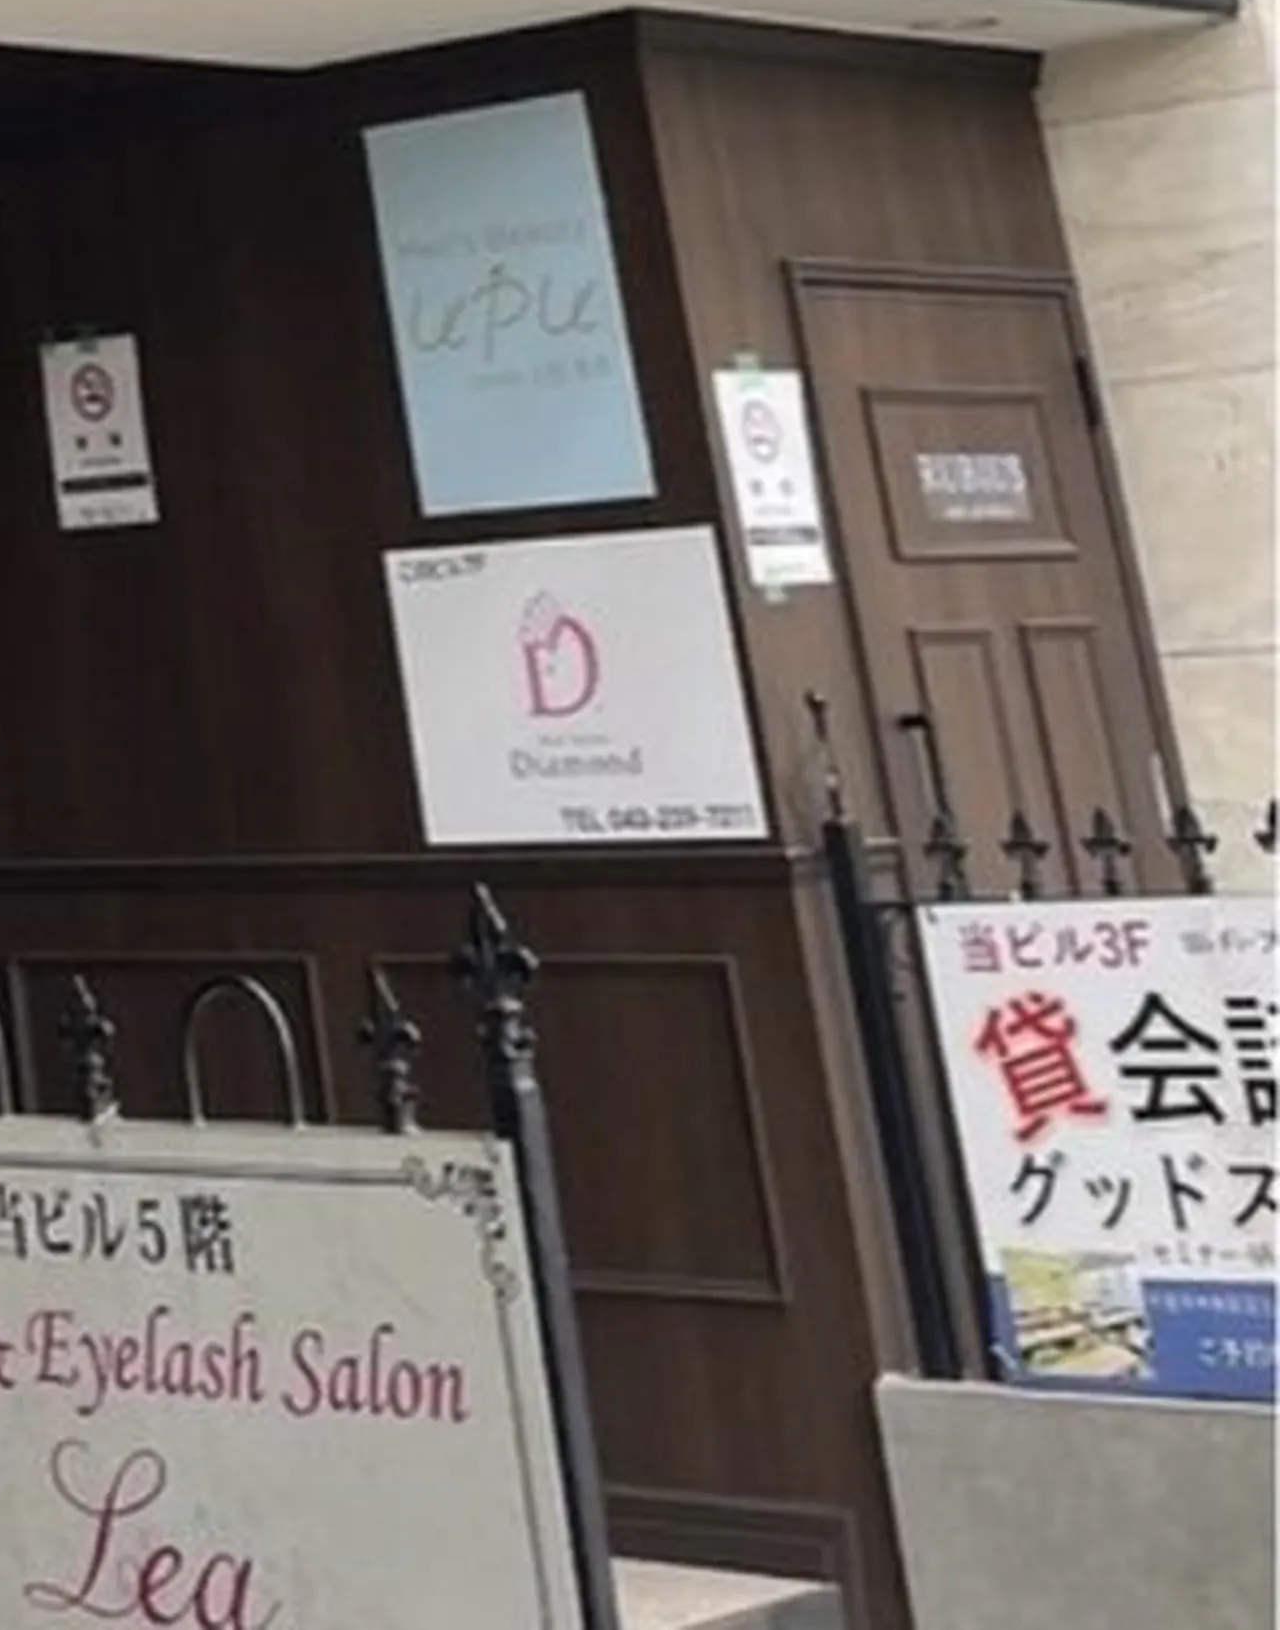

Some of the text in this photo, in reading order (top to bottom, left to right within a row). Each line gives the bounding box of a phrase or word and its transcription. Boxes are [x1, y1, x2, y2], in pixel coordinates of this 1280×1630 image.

[958, 919, 1149, 972] 当ビル3F
[1009, 1150, 1277, 1230] グッドス
[24, 1304, 265, 1417] Eyelash
[281, 1322, 469, 1424] Salon
